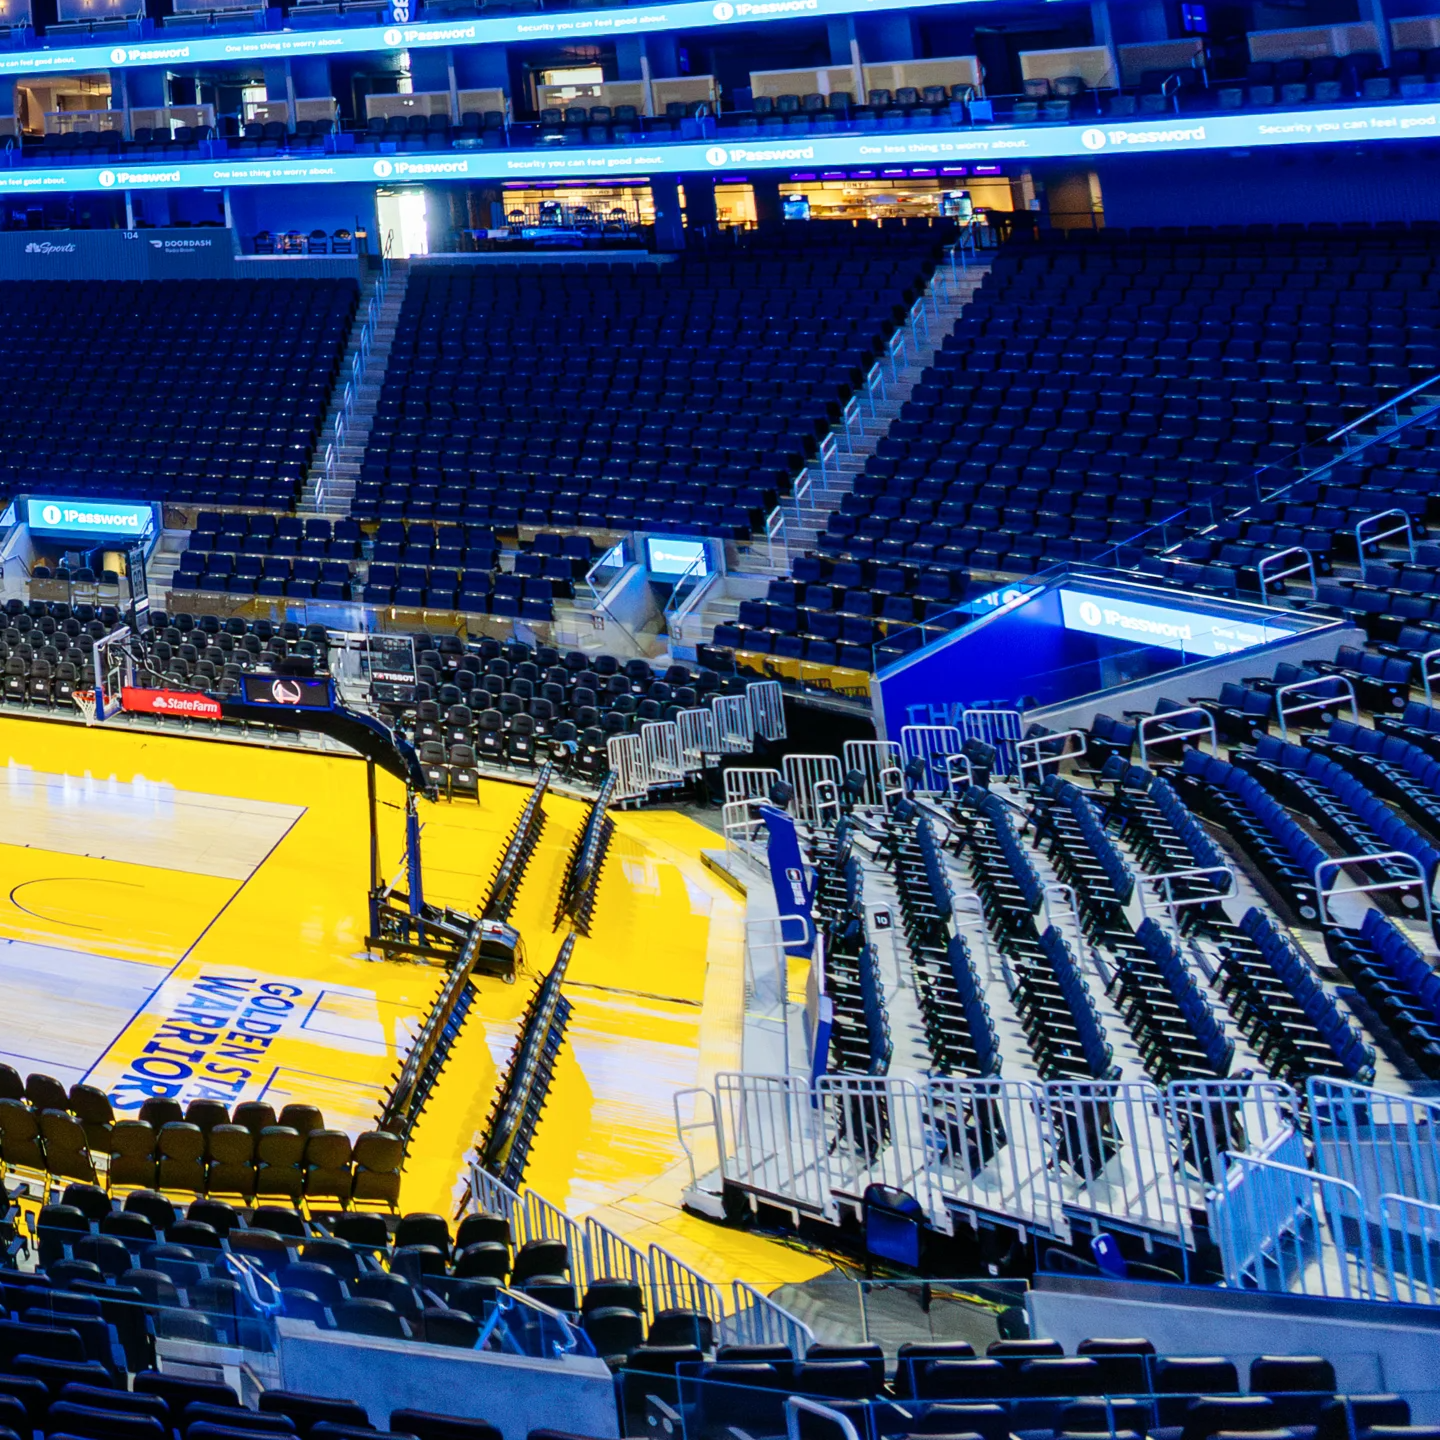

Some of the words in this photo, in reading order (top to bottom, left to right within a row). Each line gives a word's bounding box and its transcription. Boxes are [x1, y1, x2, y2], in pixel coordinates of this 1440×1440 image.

[403, 24, 475, 43] 1Password
[128, 45, 189, 61] 1Password
[225, 44, 241, 53] One
[243, 43, 258, 51] less
[260, 41, 281, 51] thing
[293, 39, 315, 48] worry
[318, 37, 345, 46] about.
[20, 58, 33, 66] feel
[34, 57, 52, 67] good
[54, 55, 77, 64] about.
[1258, 121, 1311, 135] Security
[1316, 122, 1340, 132] you
[1344, 120, 1367, 129] can
[1371, 116, 1397, 128] feel
[1401, 115, 1439, 128] good
[1108, 125, 1206, 145] 1Password
[730, 145, 814, 162] 1Password
[859, 144, 881, 155] One
[884, 144, 905, 153] less
[908, 142, 938, 154] thing
[956, 141, 988, 151] worry
[992, 139, 1030, 149] about.
[394, 158, 468, 175] 1Password
[507, 159, 545, 169] Security
[548, 160, 565, 168] you
[568, 159, 585, 167] can
[587, 157, 605, 166] feel
[608, 157, 632, 167] good
[634, 155, 665, 164] about.
[117, 169, 180, 184] 1Password
[213, 170, 230, 178] One
[250, 169, 271, 178] thing
[284, 168, 307, 176] worry
[309, 167, 337, 175] about.
[9, 177, 22, 185] feel
[24, 177, 42, 186] good
[44, 176, 67, 184] about.
[123, 231, 139, 240] 104
[39, 242, 76, 255] Sports
[164, 240, 212, 248] DOORDASH
[63, 509, 138, 528] 1Password
[1103, 609, 1192, 641] 1Password
[384, 673, 414, 682] TISSOT
[215, 982, 303, 1064] GOLDEN
[107, 975, 257, 1112] WARRIORS
